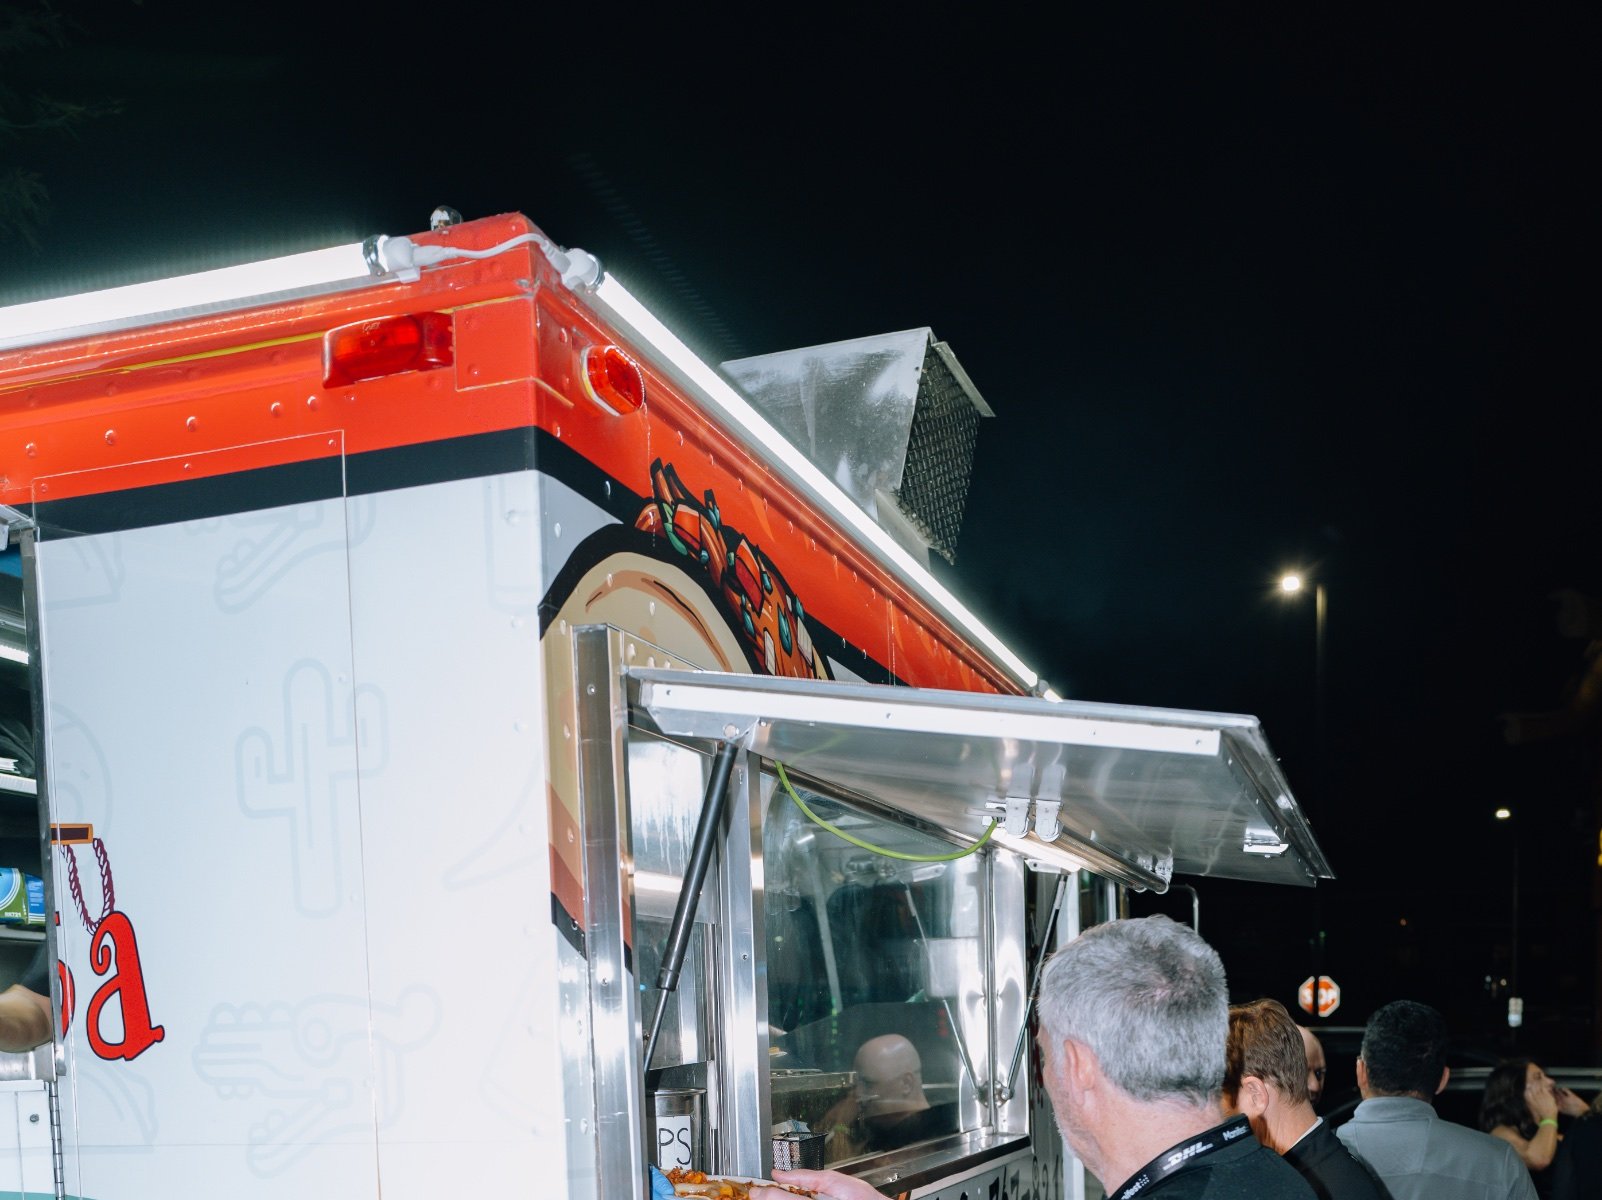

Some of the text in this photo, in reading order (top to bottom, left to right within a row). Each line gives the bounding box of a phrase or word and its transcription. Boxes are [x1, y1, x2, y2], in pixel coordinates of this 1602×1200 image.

[55, 910, 165, 1061] a
[1301, 987, 1338, 1005] SOP
[1166, 1141, 1207, 1167] DHL
